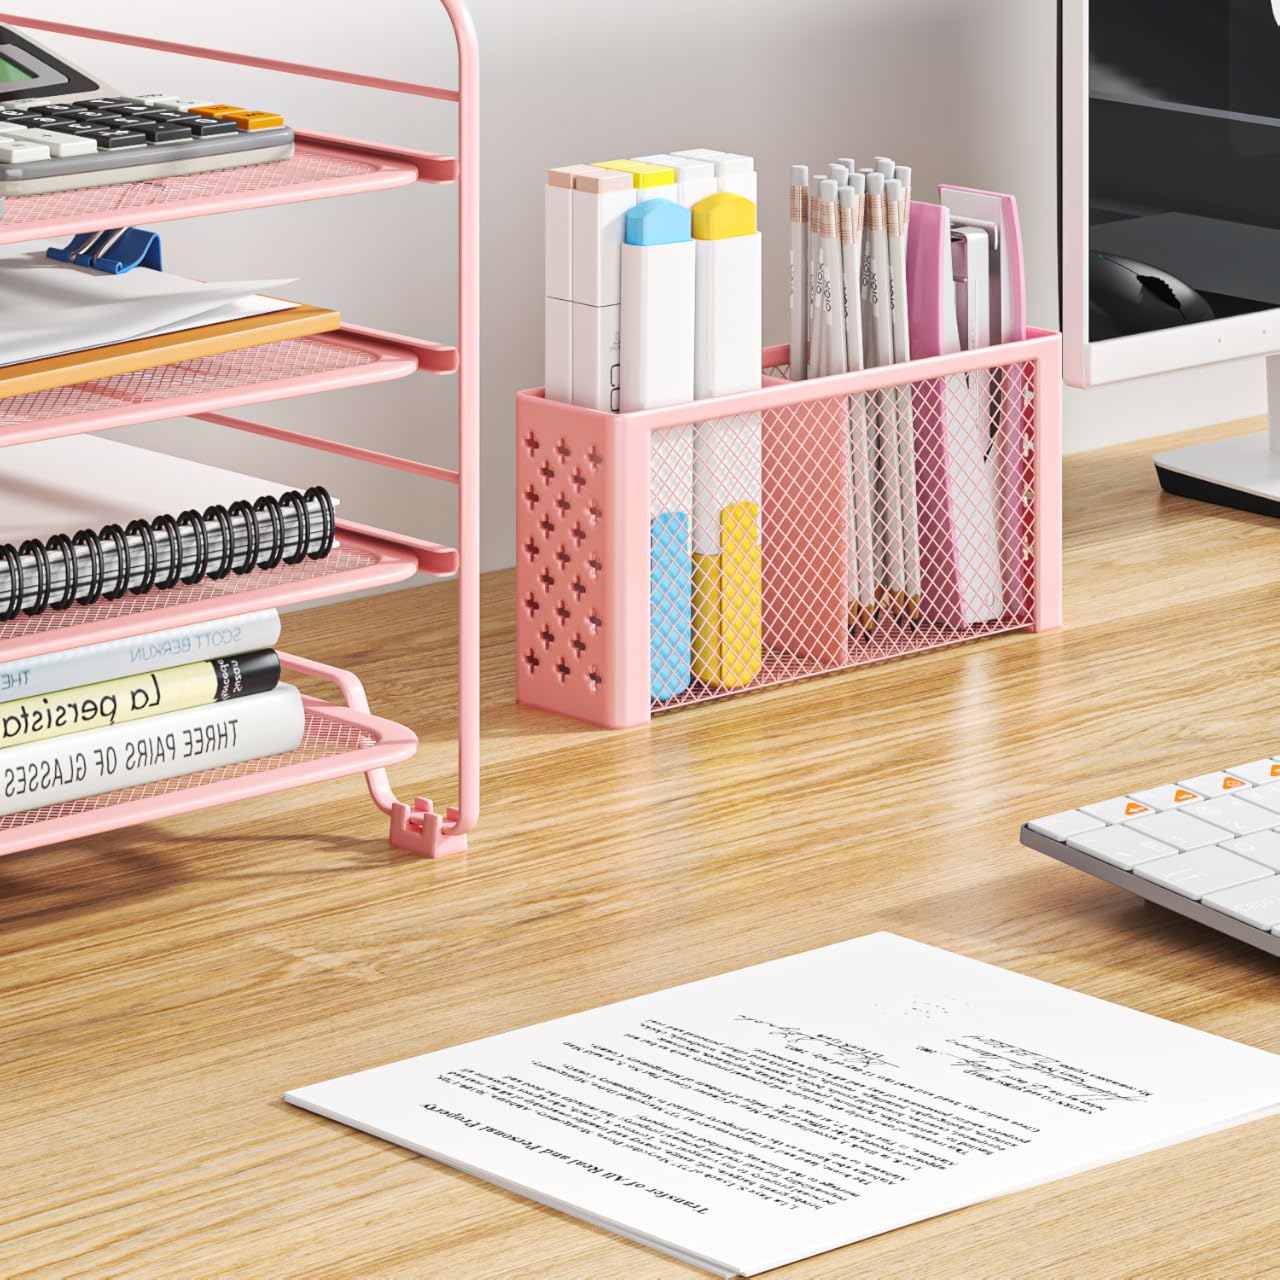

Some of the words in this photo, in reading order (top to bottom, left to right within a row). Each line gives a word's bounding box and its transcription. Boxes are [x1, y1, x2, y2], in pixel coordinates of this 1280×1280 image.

[419, 1103, 482, 1128] Property
[477, 1125, 544, 1151] Personal
[538, 1148, 572, 1160] and
[565, 1159, 605, 1174] Real
[600, 1172, 630, 1182] All
[622, 1181, 646, 1189] of
[644, 1188, 710, 1215] Transfer
